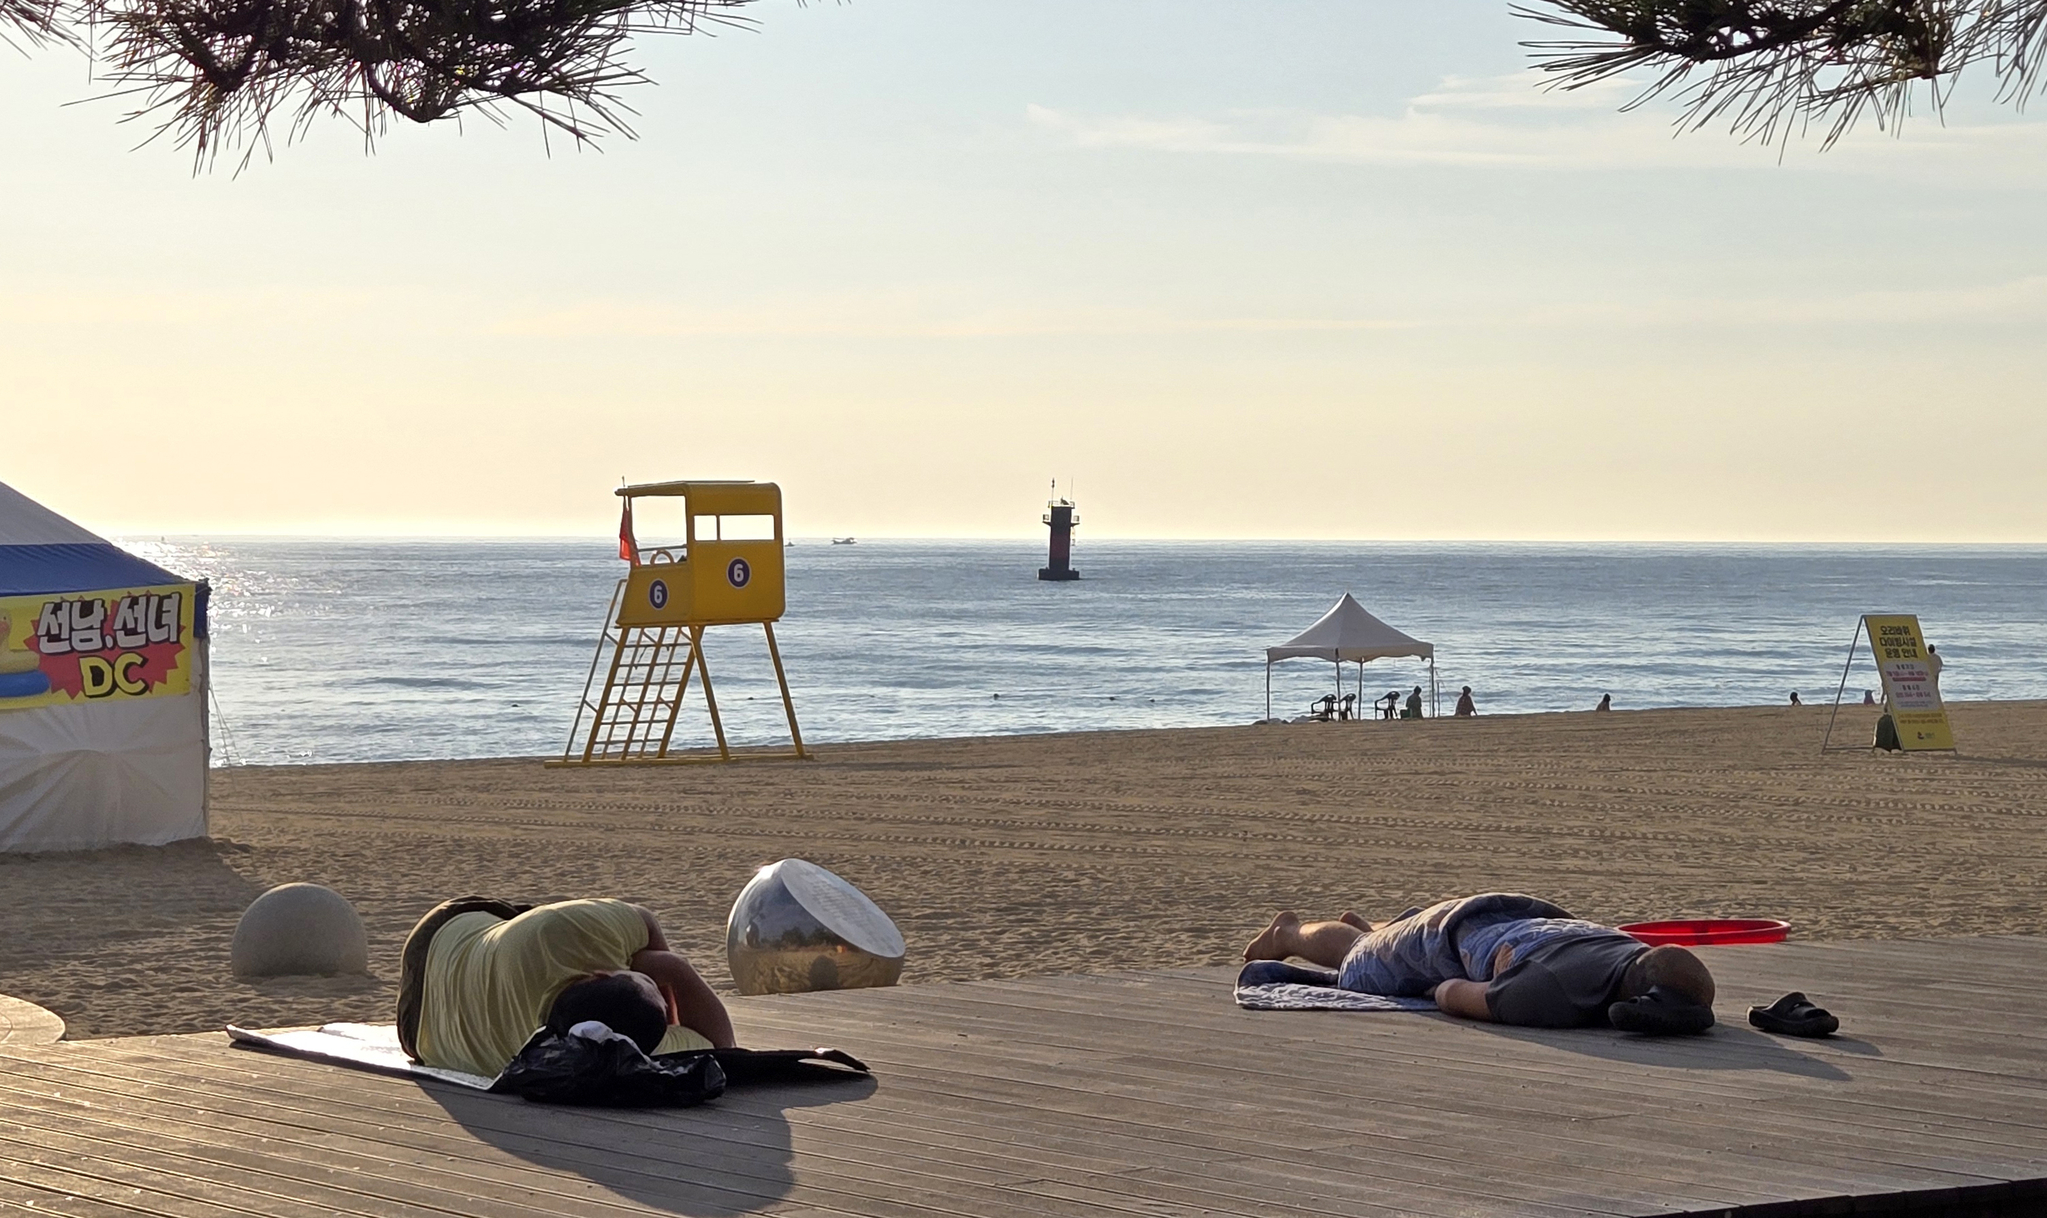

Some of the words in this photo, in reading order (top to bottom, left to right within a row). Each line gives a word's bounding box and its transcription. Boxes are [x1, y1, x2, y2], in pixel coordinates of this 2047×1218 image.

[734, 563, 744, 582] 6
[654, 585, 663, 604] 6
[37, 591, 180, 654] 선남.선녀
[1880, 625, 1911, 636] 오리바위
[1879, 636, 1917, 648] 다이빙시설
[1885, 647, 1901, 659] 운영
[1901, 648, 1918, 659] 안내
[79, 651, 148, 698] DC
